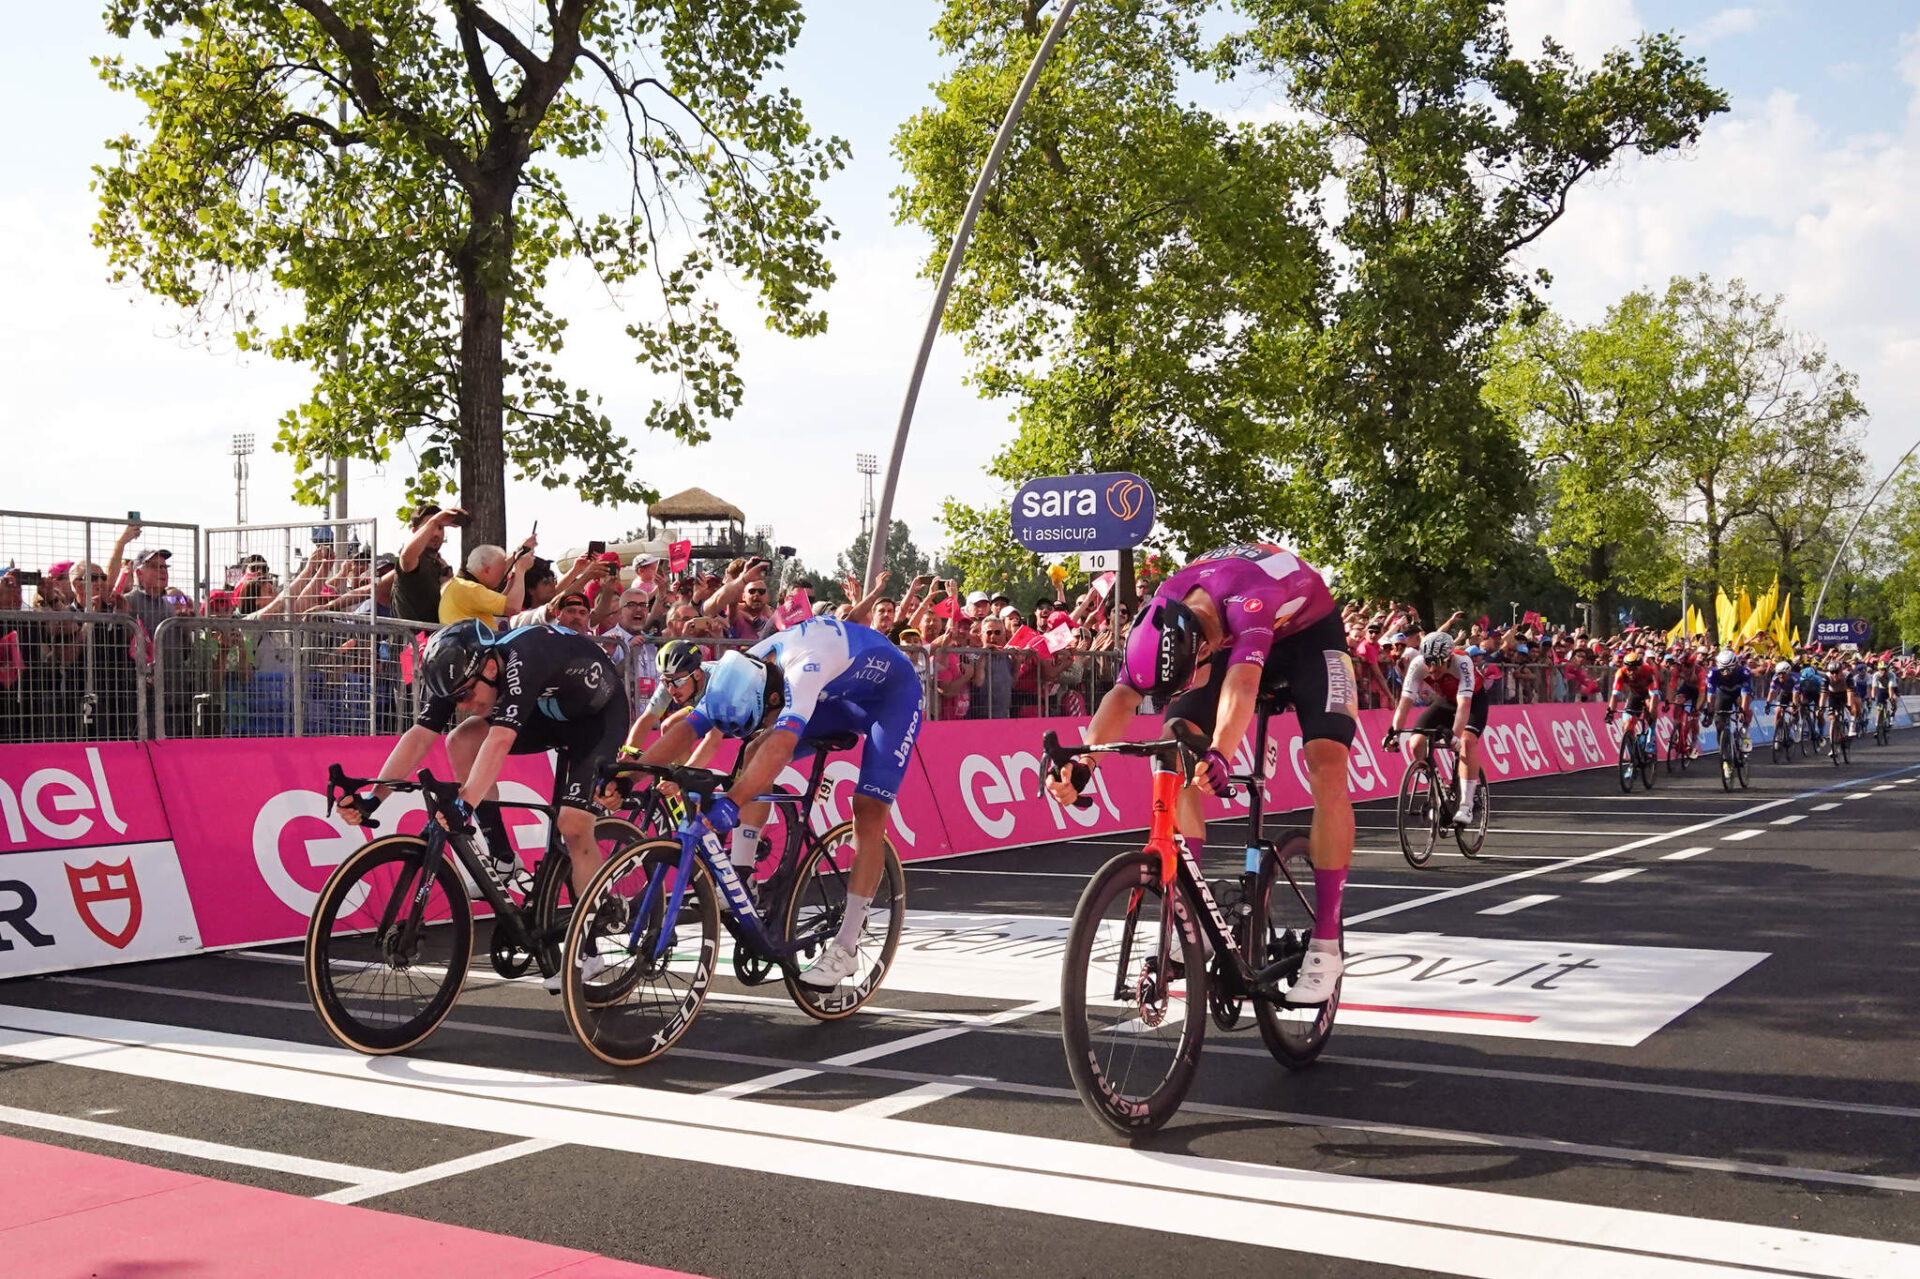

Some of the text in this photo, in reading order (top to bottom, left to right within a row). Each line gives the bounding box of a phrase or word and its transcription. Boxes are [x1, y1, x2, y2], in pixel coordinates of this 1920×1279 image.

[1022, 487, 1097, 518] sara
[1022, 526, 1096, 541] ti assicura
[1089, 555, 1105, 568] 10
[1161, 623, 1171, 682] RUDY
[1817, 623, 1849, 633] sara
[1327, 656, 1345, 704] BAHRAIN
[894, 710, 919, 768] Jayco
[1289, 717, 1388, 794] eel
[1483, 710, 1550, 775] enel
[1551, 707, 1606, 765] enel
[817, 777, 834, 803] 191
[467, 839, 518, 906] SCOTT
[702, 832, 760, 919] GIANT
[1173, 833, 1237, 949] MERIDA
[650, 938, 716, 1053] CADEX
